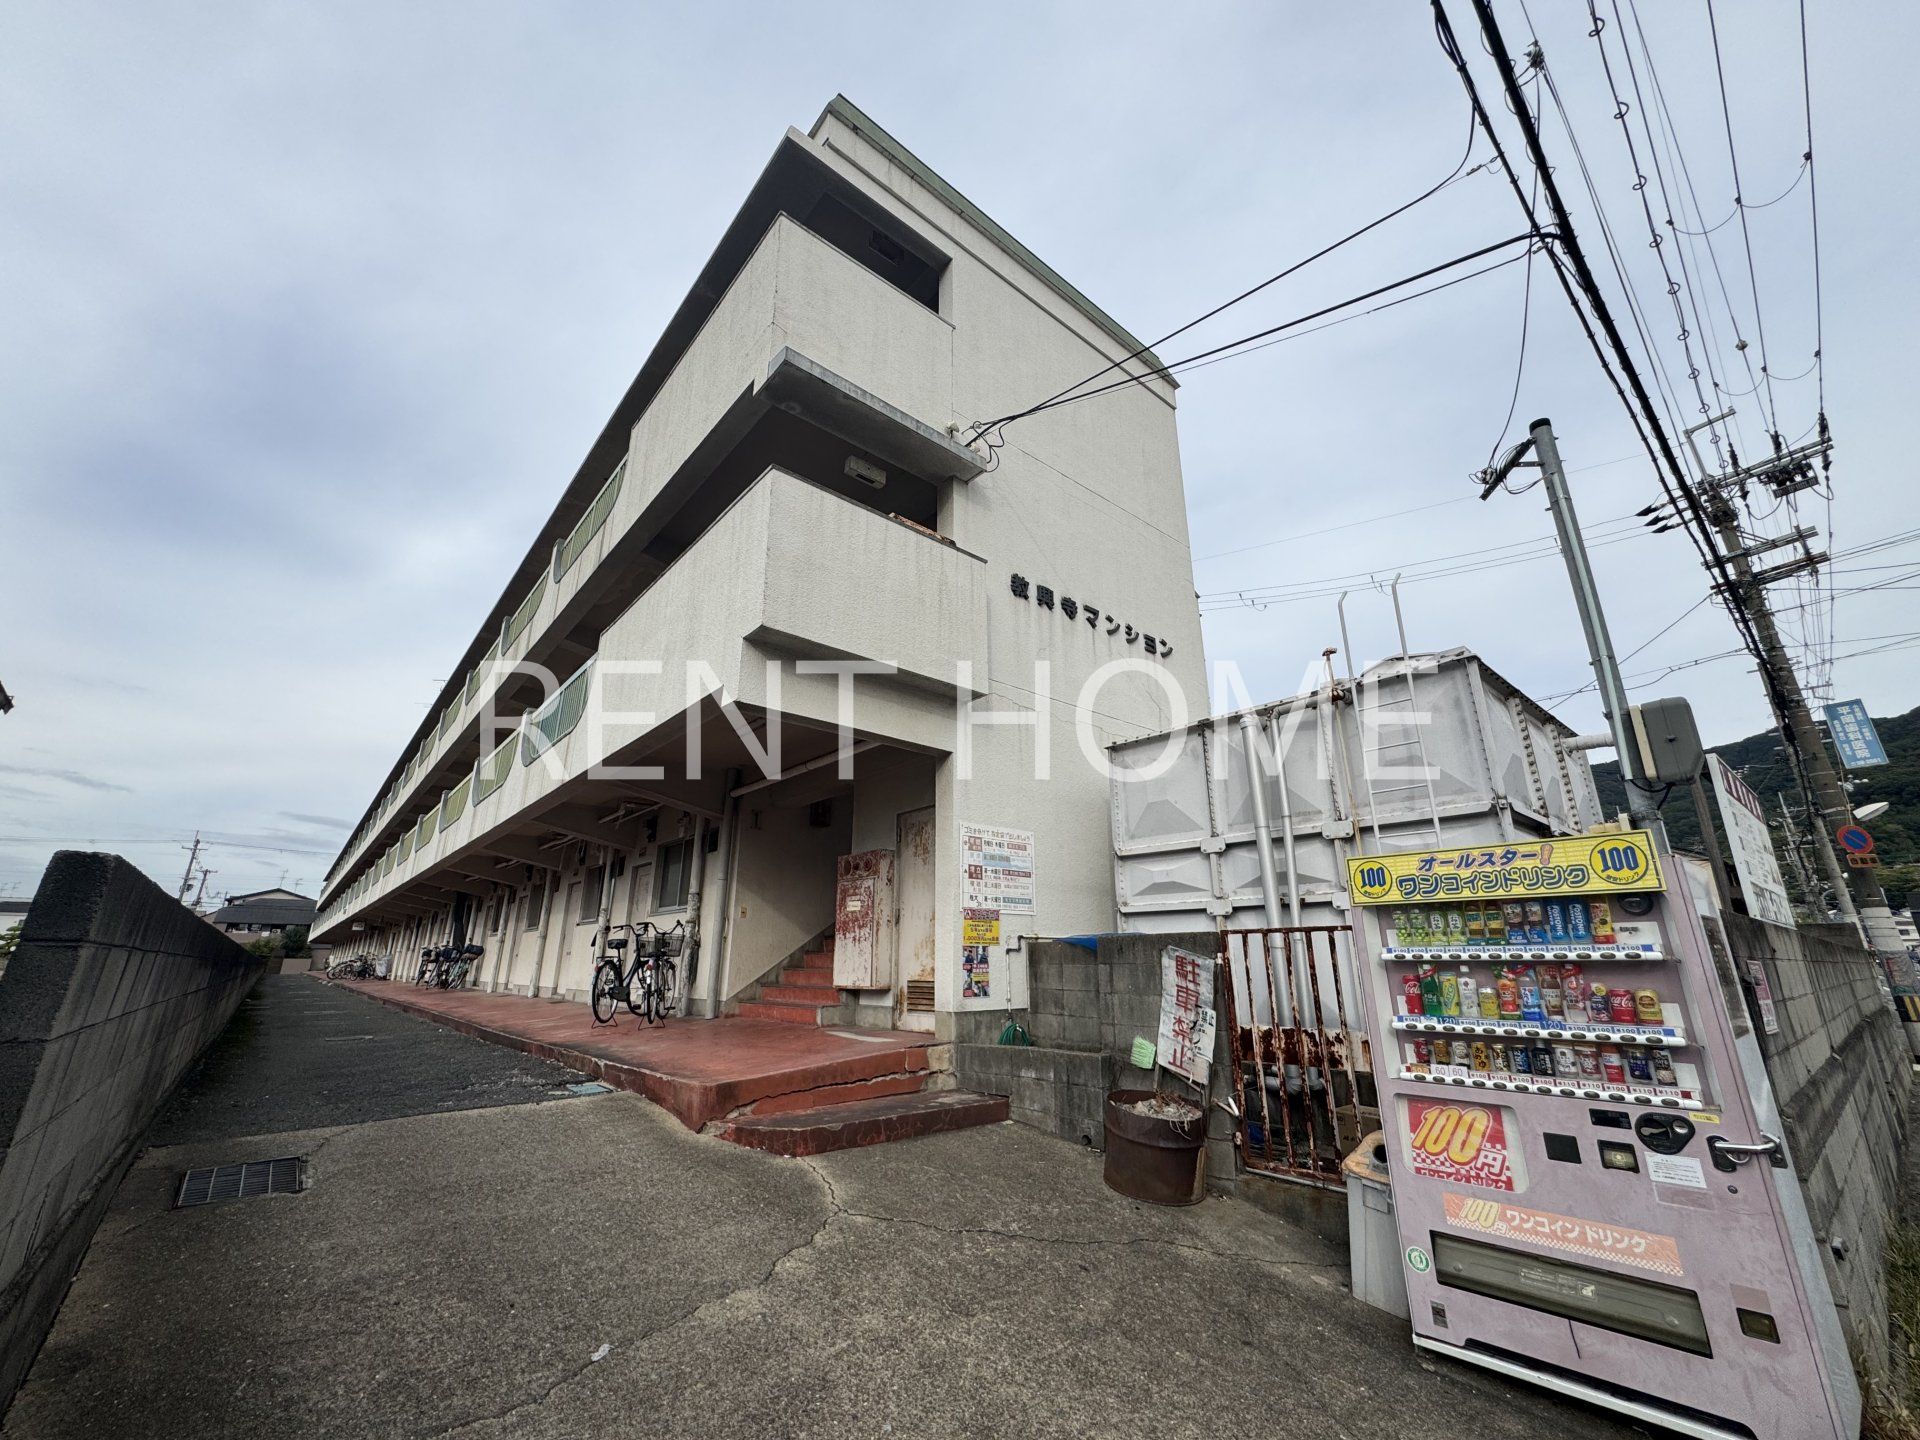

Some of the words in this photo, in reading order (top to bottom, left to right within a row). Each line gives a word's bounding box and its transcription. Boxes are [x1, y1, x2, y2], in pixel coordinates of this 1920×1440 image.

[1597, 845, 1640, 872] 100
[1359, 866, 1387, 889] 100
[1396, 864, 1590, 900] ワンコインドリンク
[1435, 1067, 1446, 1075] 60
[1452, 1068, 1463, 1077] 60
[1505, 1209, 1580, 1239] ワンコイン
